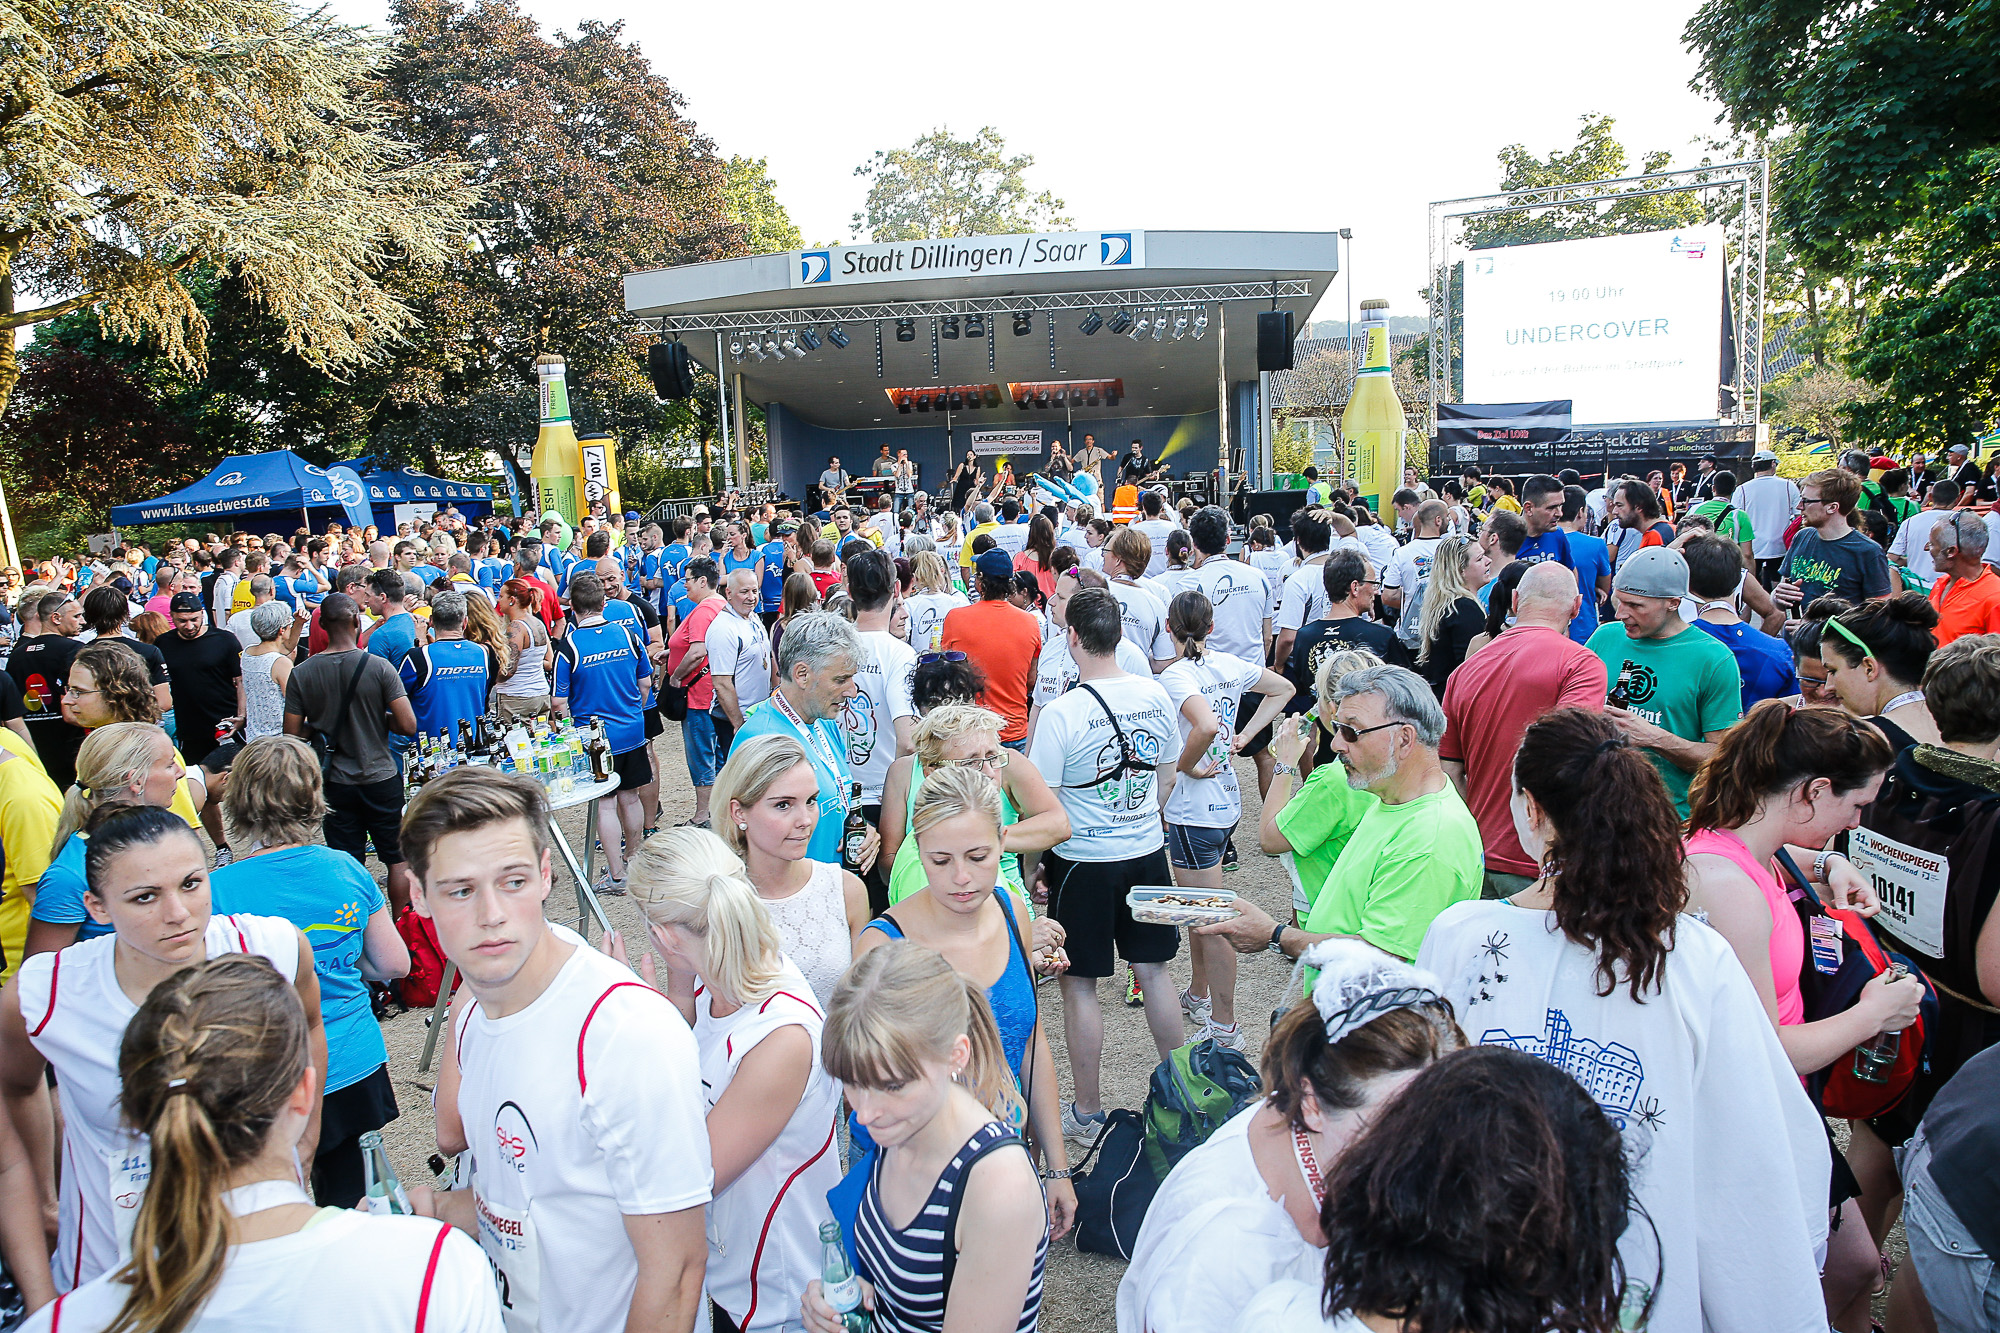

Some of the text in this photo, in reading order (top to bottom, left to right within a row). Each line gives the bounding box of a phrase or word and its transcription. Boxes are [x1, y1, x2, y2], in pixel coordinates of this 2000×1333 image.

[842, 246, 903, 276] Stadt
[910, 243, 1013, 273] Dillingen
[1033, 238, 1088, 263] Saar
[1596, 286, 1625, 299] Uhr
[1506, 318, 1669, 346] UNDERCOVER
[1367, 335, 1375, 361] RADLER
[973, 434, 1040, 442] UNDERCOVER
[1668, 443, 1715, 452] audiocheck
[975, 445, 1040, 453] www.mission2rock.de
[1580, 447, 1649, 456] Veranstltungstechnik
[587, 450, 602, 479] 101,7
[1347, 439, 1357, 480] ADLER
[141, 495, 271, 520] www.ikk-suedwest.de
[544, 488, 555, 511] ESH
[1216, 585, 1249, 595] TRUCKTEC
[617, 617, 635, 627] TUS
[921, 618, 945, 626] TRUCKT
[1119, 616, 1140, 625] CKTEC
[856, 663, 882, 675] netzt.
[1088, 708, 1166, 730] Kreaiv vernetzt.
[1626, 705, 1662, 725] ment
[1855, 832, 1940, 873] 11. WOCHENSPIEGEL
[1857, 846, 1919, 876] Firmenlauf Saarland
[1871, 873, 1915, 917] 10141
[1880, 904, 1907, 925] nna-Maria
[121, 1155, 147, 1172] 11.
